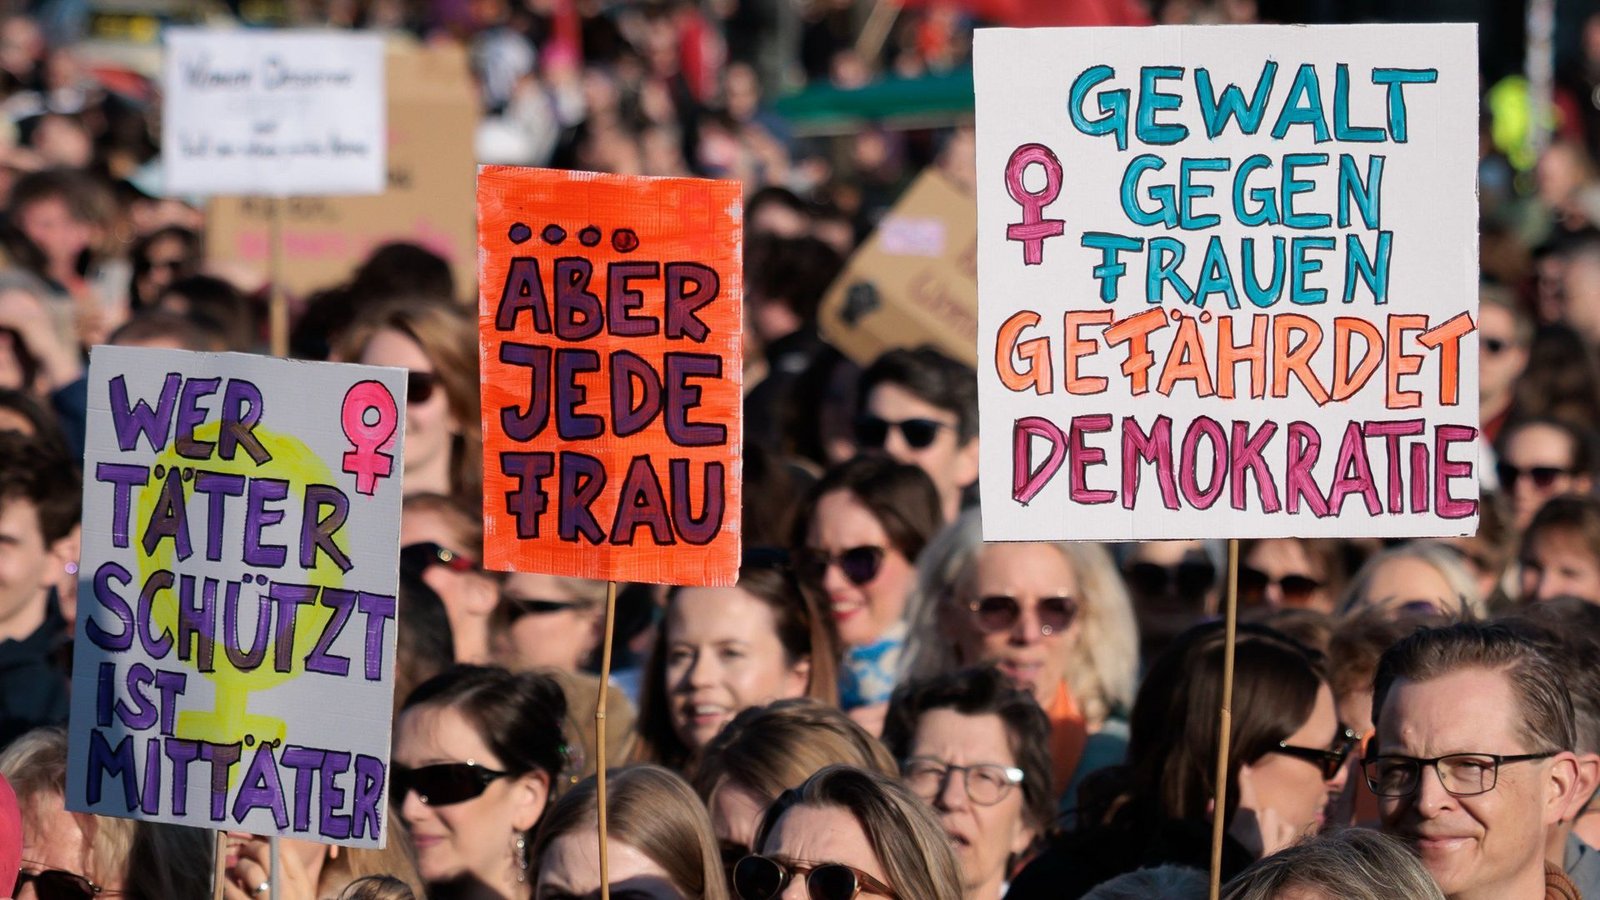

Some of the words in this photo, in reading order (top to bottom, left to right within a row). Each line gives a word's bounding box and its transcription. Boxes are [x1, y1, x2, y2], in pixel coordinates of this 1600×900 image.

[1067, 60, 1438, 151] GEWALT
[1120, 153, 1387, 230] GEGEN
[495, 256, 720, 343] ABER
[1081, 231, 1394, 309] FRAUEN
[500, 342, 728, 446] JEDE
[995, 306, 1479, 410] GEFÄHRDET
[108, 372, 273, 466] WER
[500, 451, 725, 545] FRAU
[1012, 414, 1479, 520] DEMOKRATIE
[95, 462, 354, 574] TÄTER
[85, 561, 397, 681] SCHÜTZT
[97, 662, 188, 736] IST
[86, 729, 387, 841] MITTÄTER
